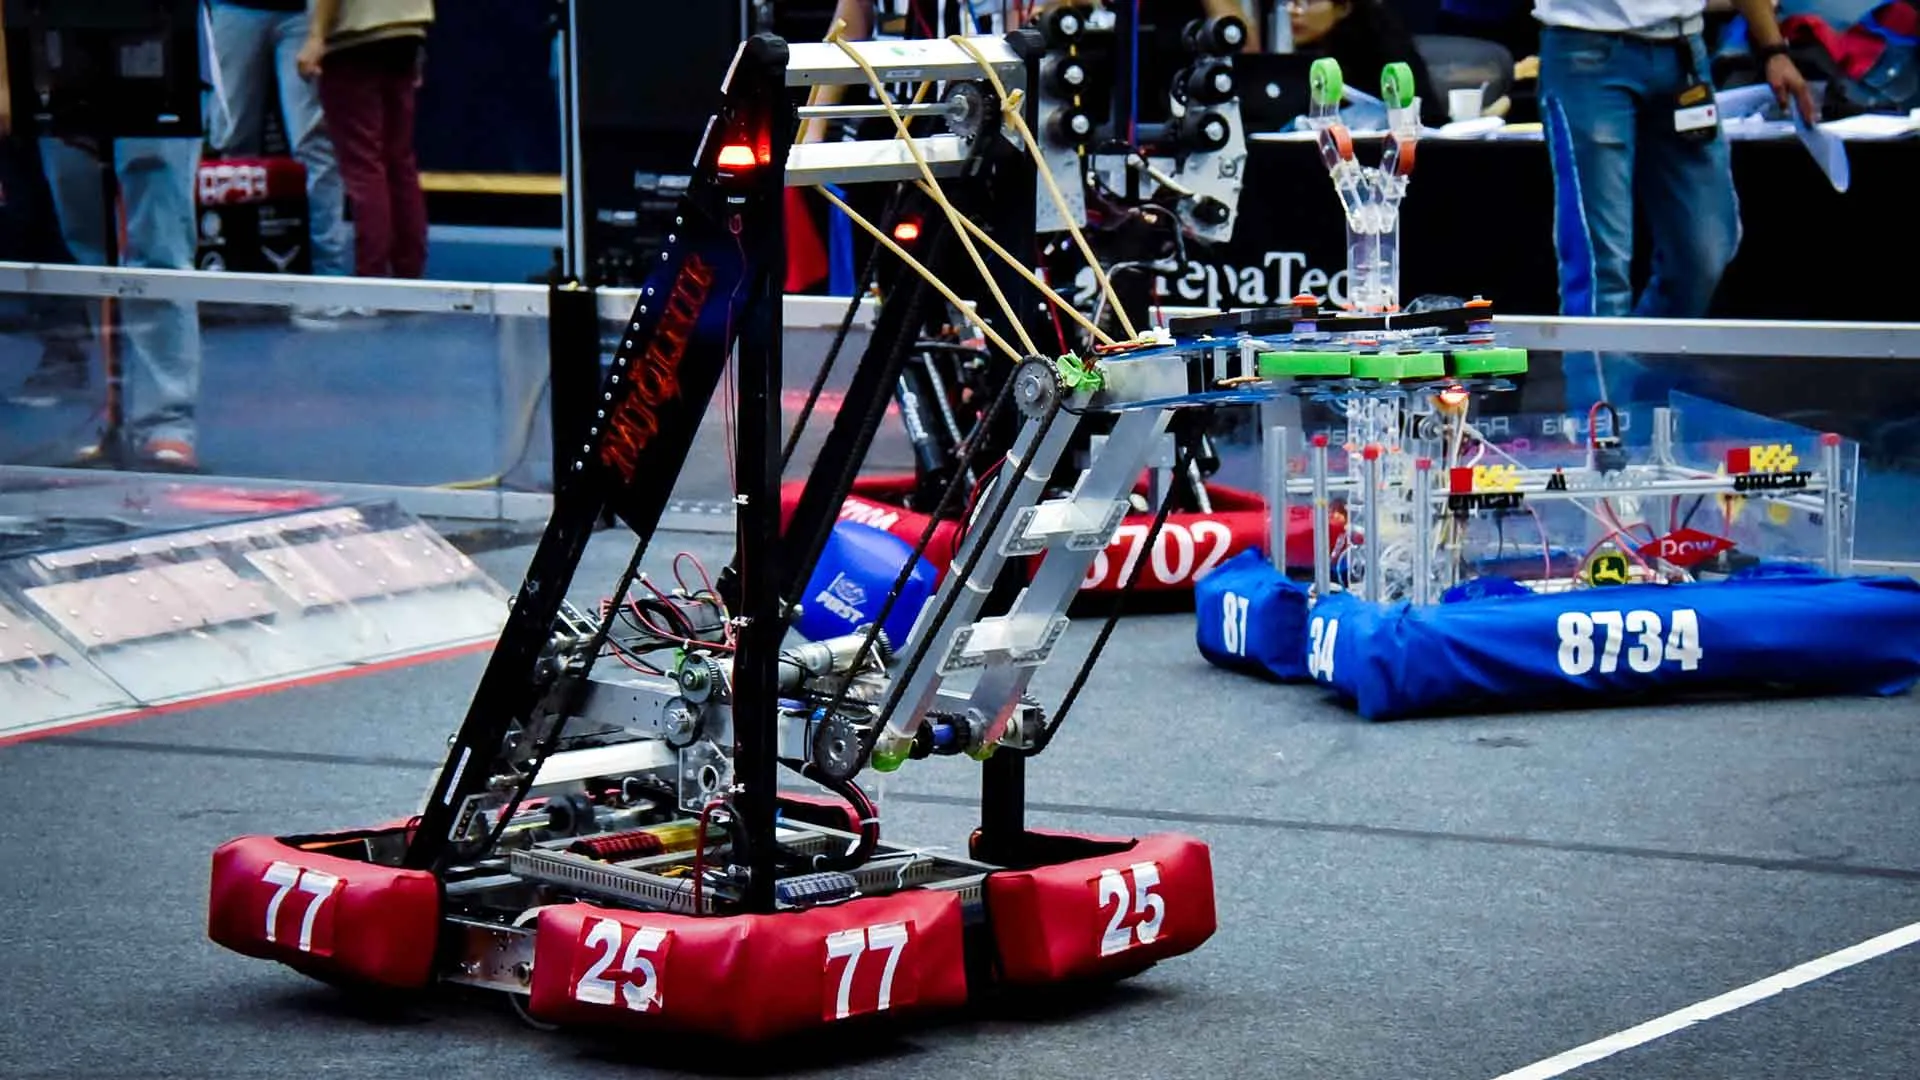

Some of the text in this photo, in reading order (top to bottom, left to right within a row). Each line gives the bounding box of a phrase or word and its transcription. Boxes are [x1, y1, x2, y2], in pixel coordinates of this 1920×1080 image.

[1223, 591, 1249, 657] 87
[1308, 616, 1338, 682] 34
[1557, 609, 1703, 675] 8734
[261, 861, 341, 951] 77
[1099, 861, 1166, 957] 25
[576, 918, 667, 1012] 25
[824, 921, 909, 1019] 77
